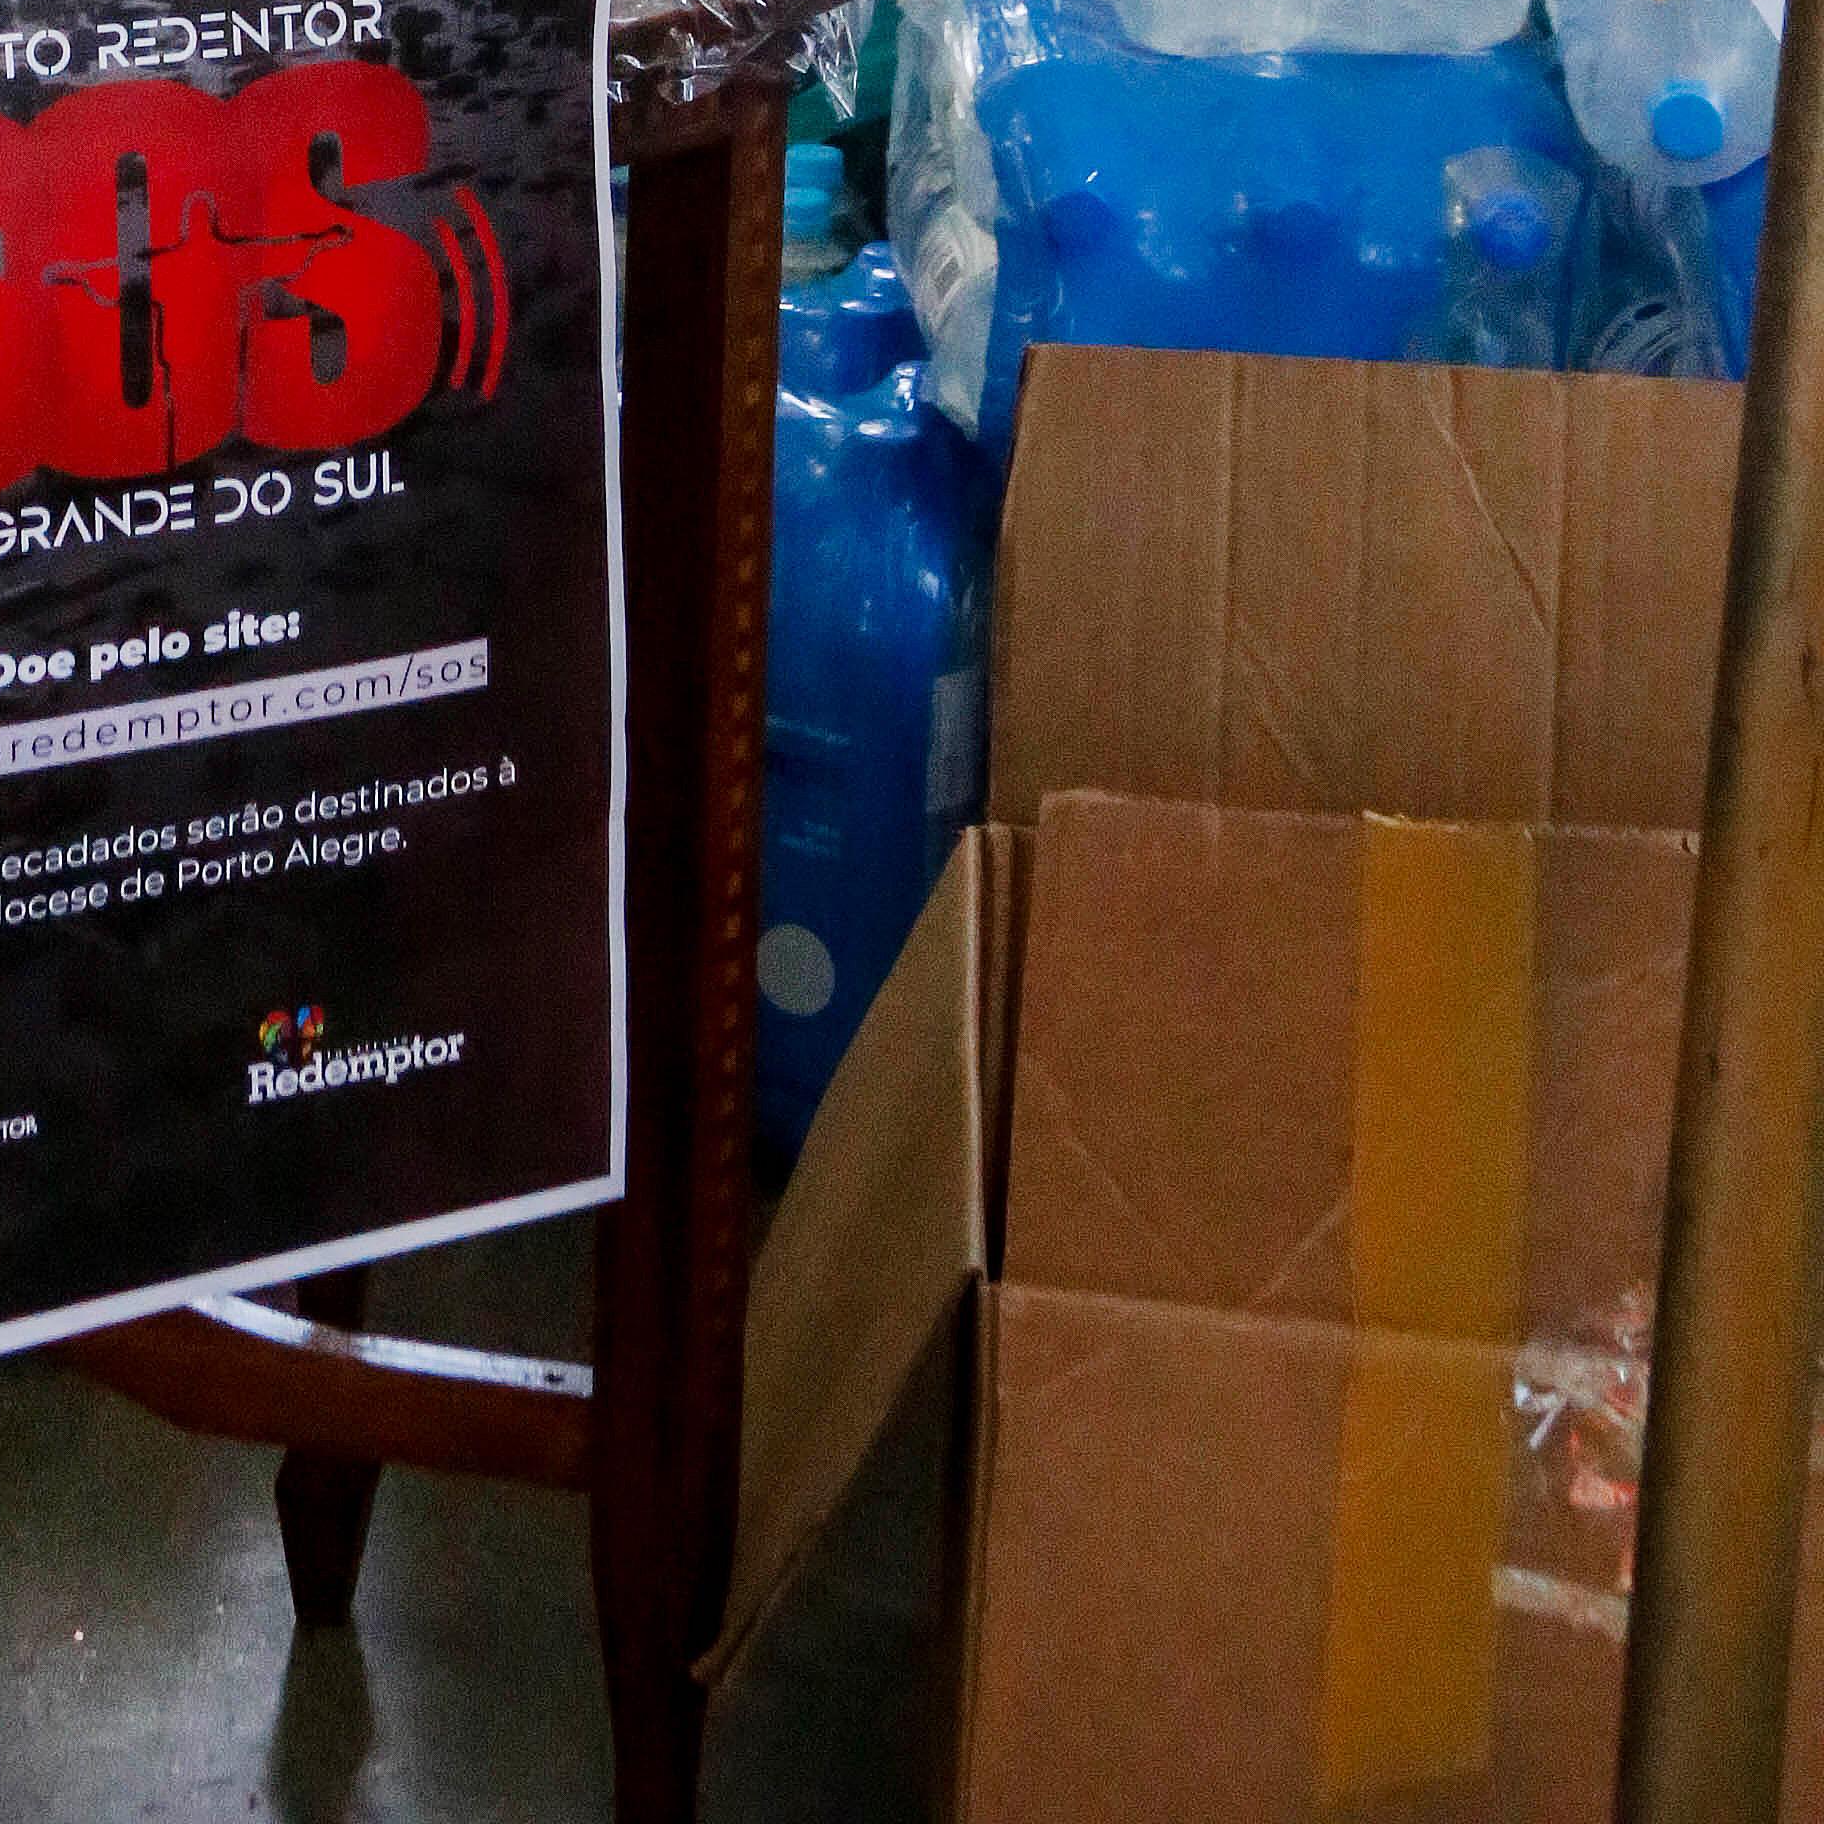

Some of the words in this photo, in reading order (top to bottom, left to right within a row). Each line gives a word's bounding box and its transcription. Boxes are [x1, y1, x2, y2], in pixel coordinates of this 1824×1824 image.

[214, 471, 292, 524] DO
[313, 450, 405, 506] SUL
[89, 625, 189, 682] pelo
[203, 607, 301, 652] site:
[187, 801, 284, 846] serão
[293, 764, 488, 823] destinados
[499, 755, 518, 785] à
[120, 866, 165, 900] de
[177, 847, 274, 892] Porto
[283, 824, 409, 874] Alegre.
[247, 1031, 465, 1104] Redemptor
